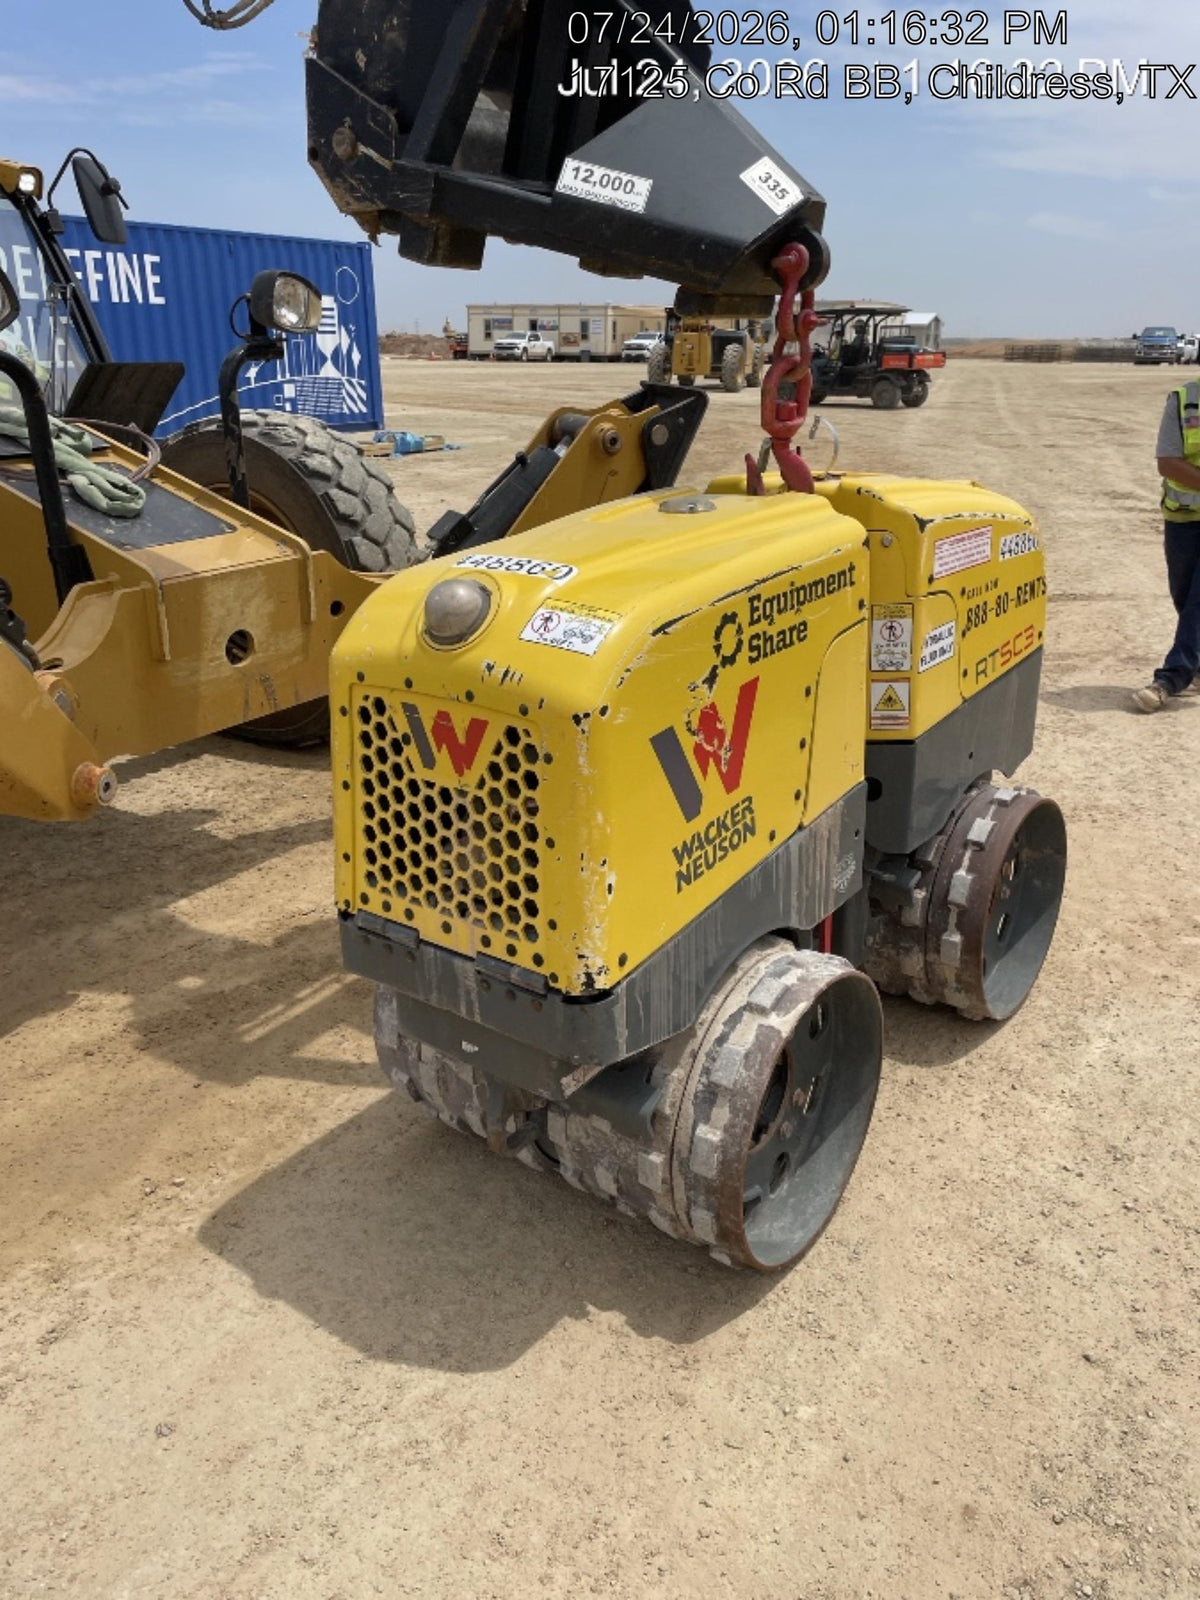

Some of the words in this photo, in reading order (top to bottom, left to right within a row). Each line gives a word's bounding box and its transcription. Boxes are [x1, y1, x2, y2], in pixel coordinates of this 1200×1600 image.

[572, 165, 635, 195] 12,000
[759, 171, 790, 200] 335
[748, 562, 855, 626] Equipment
[748, 619, 808, 664] Share
[671, 796, 755, 867] WACKER
[675, 815, 757, 894] NEUSON
